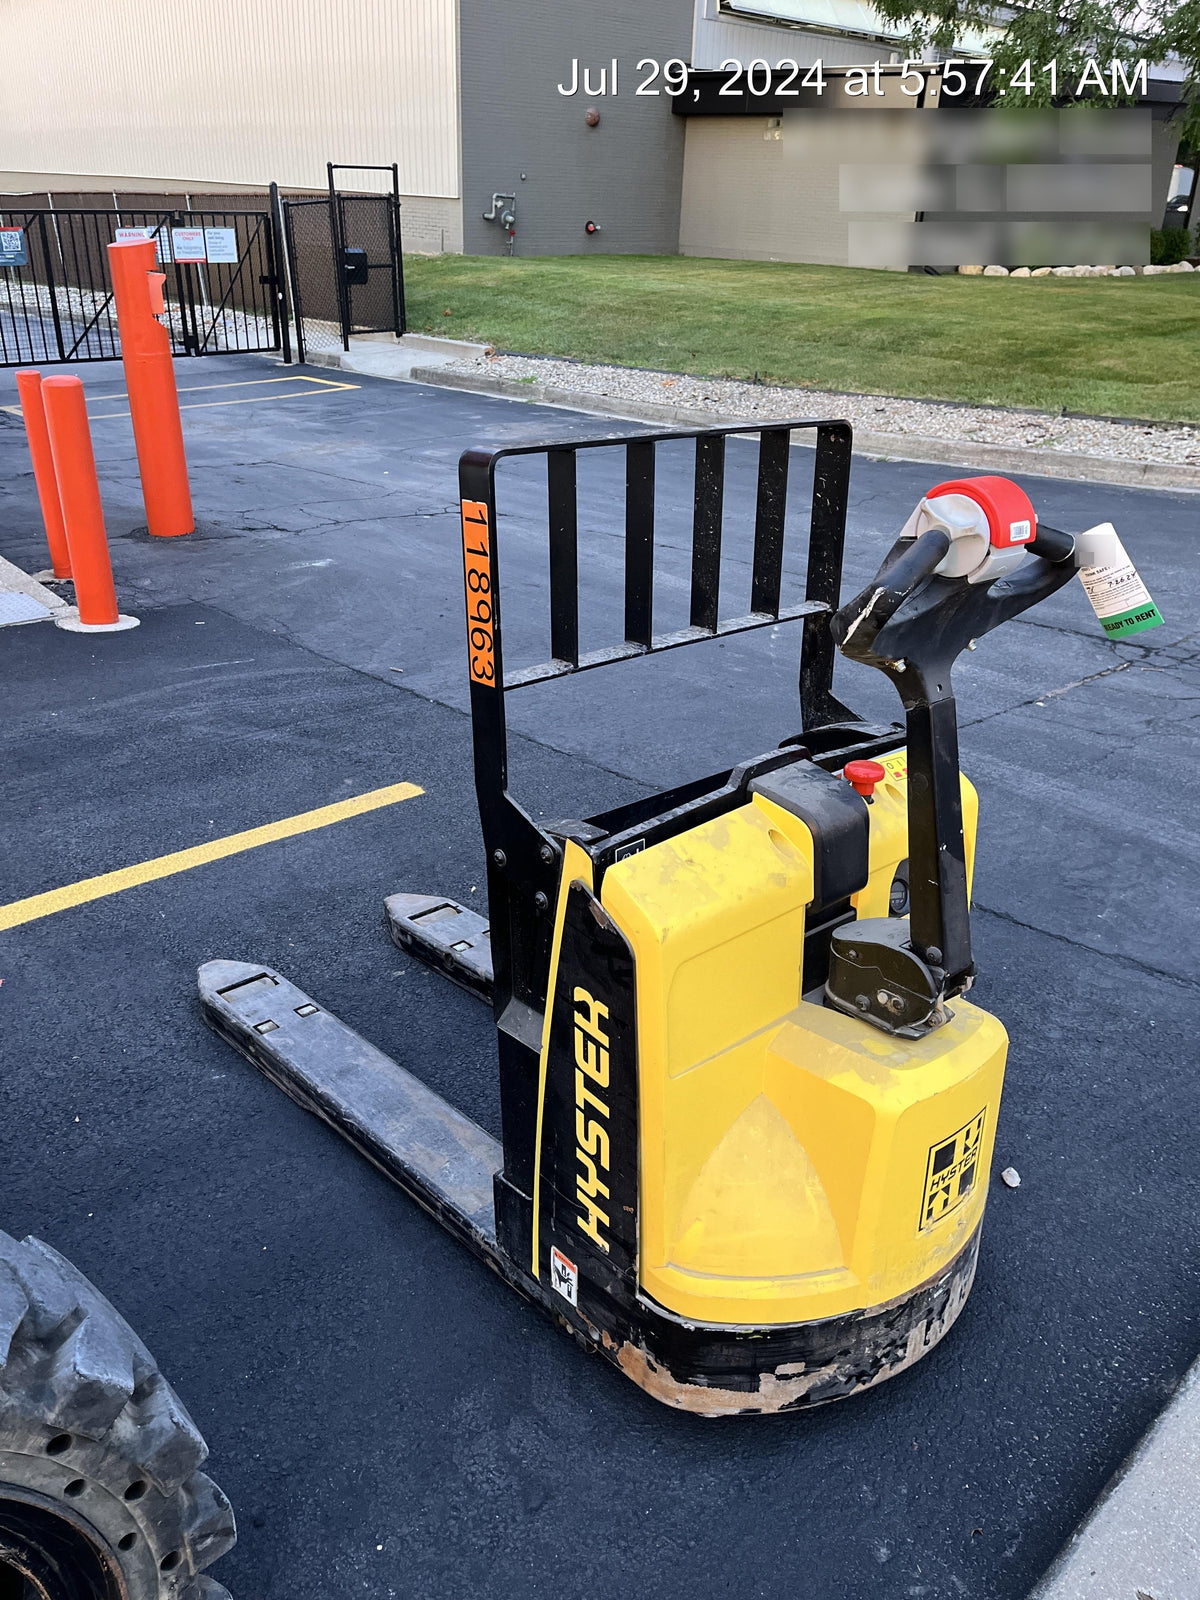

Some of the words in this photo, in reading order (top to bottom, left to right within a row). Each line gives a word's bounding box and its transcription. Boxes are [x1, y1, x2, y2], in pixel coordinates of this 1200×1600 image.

[464, 509, 496, 682] 118963
[1103, 620, 1124, 632] READY
[1124, 617, 1135, 626] TO
[1135, 609, 1156, 623] RENT
[573, 986, 610, 1256] HYSTER
[930, 1145, 978, 1192] HYSTER
